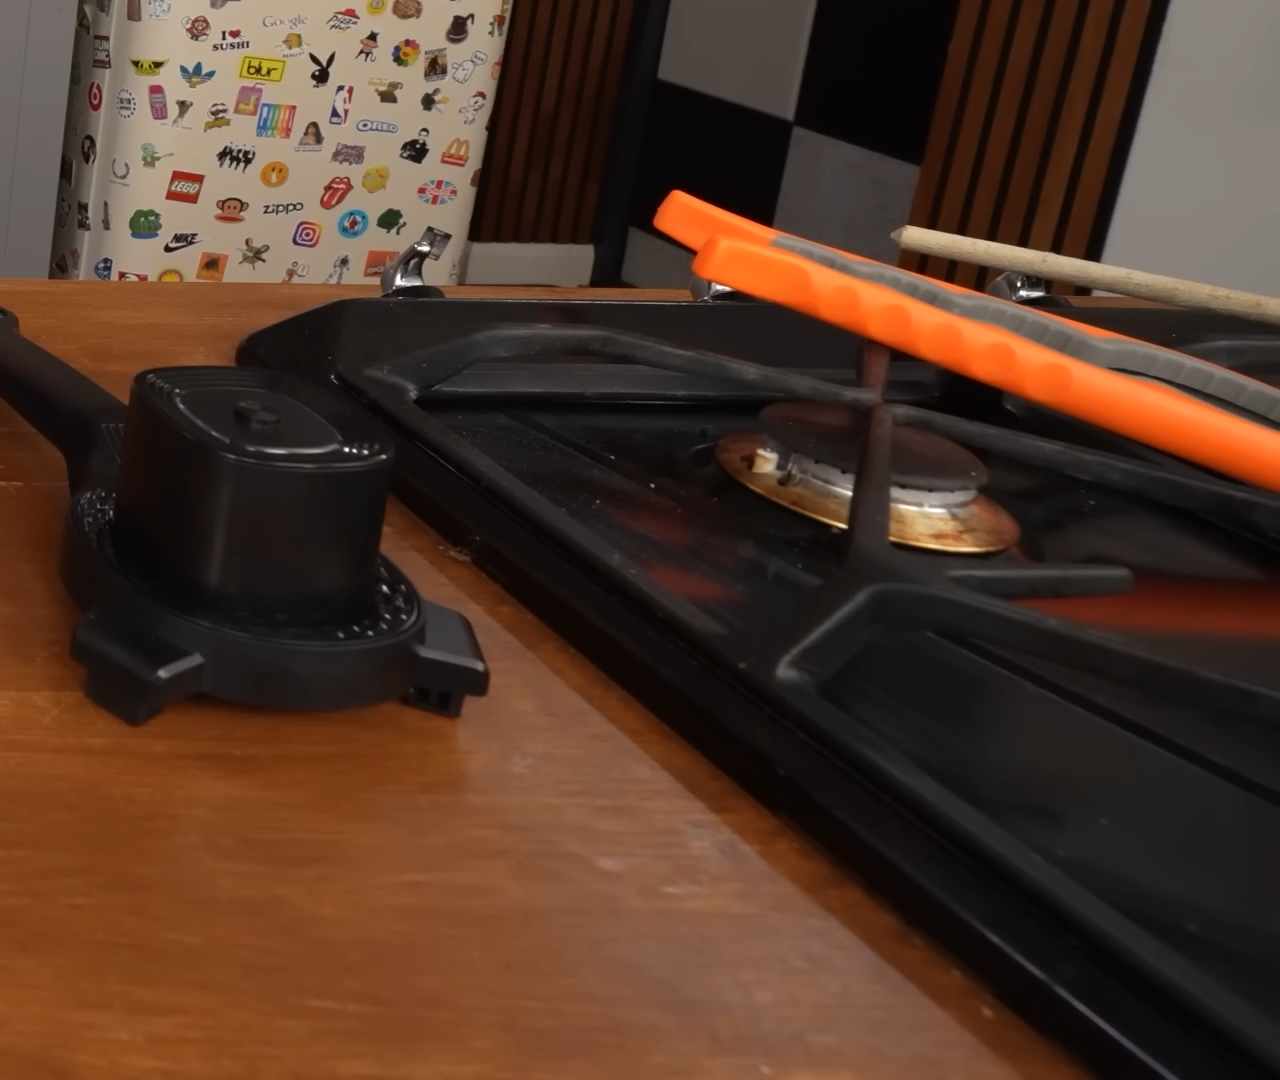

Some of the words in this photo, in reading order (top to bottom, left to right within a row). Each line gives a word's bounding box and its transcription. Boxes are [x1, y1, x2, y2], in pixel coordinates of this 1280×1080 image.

[262, 14, 308, 29] Google
[329, 22, 352, 32] Hut
[221, 31, 227, 41] I
[94, 40, 109, 50] RUN
[212, 41, 250, 51] SUSHI
[95, 50, 109, 60] DMC
[424, 47, 448, 56] BIGFOOT
[247, 60, 278, 77] blur
[357, 120, 398, 133] OREO
[171, 181, 200, 194] LEGO
[263, 202, 304, 216] zippo
[171, 232, 199, 244] NIKE
